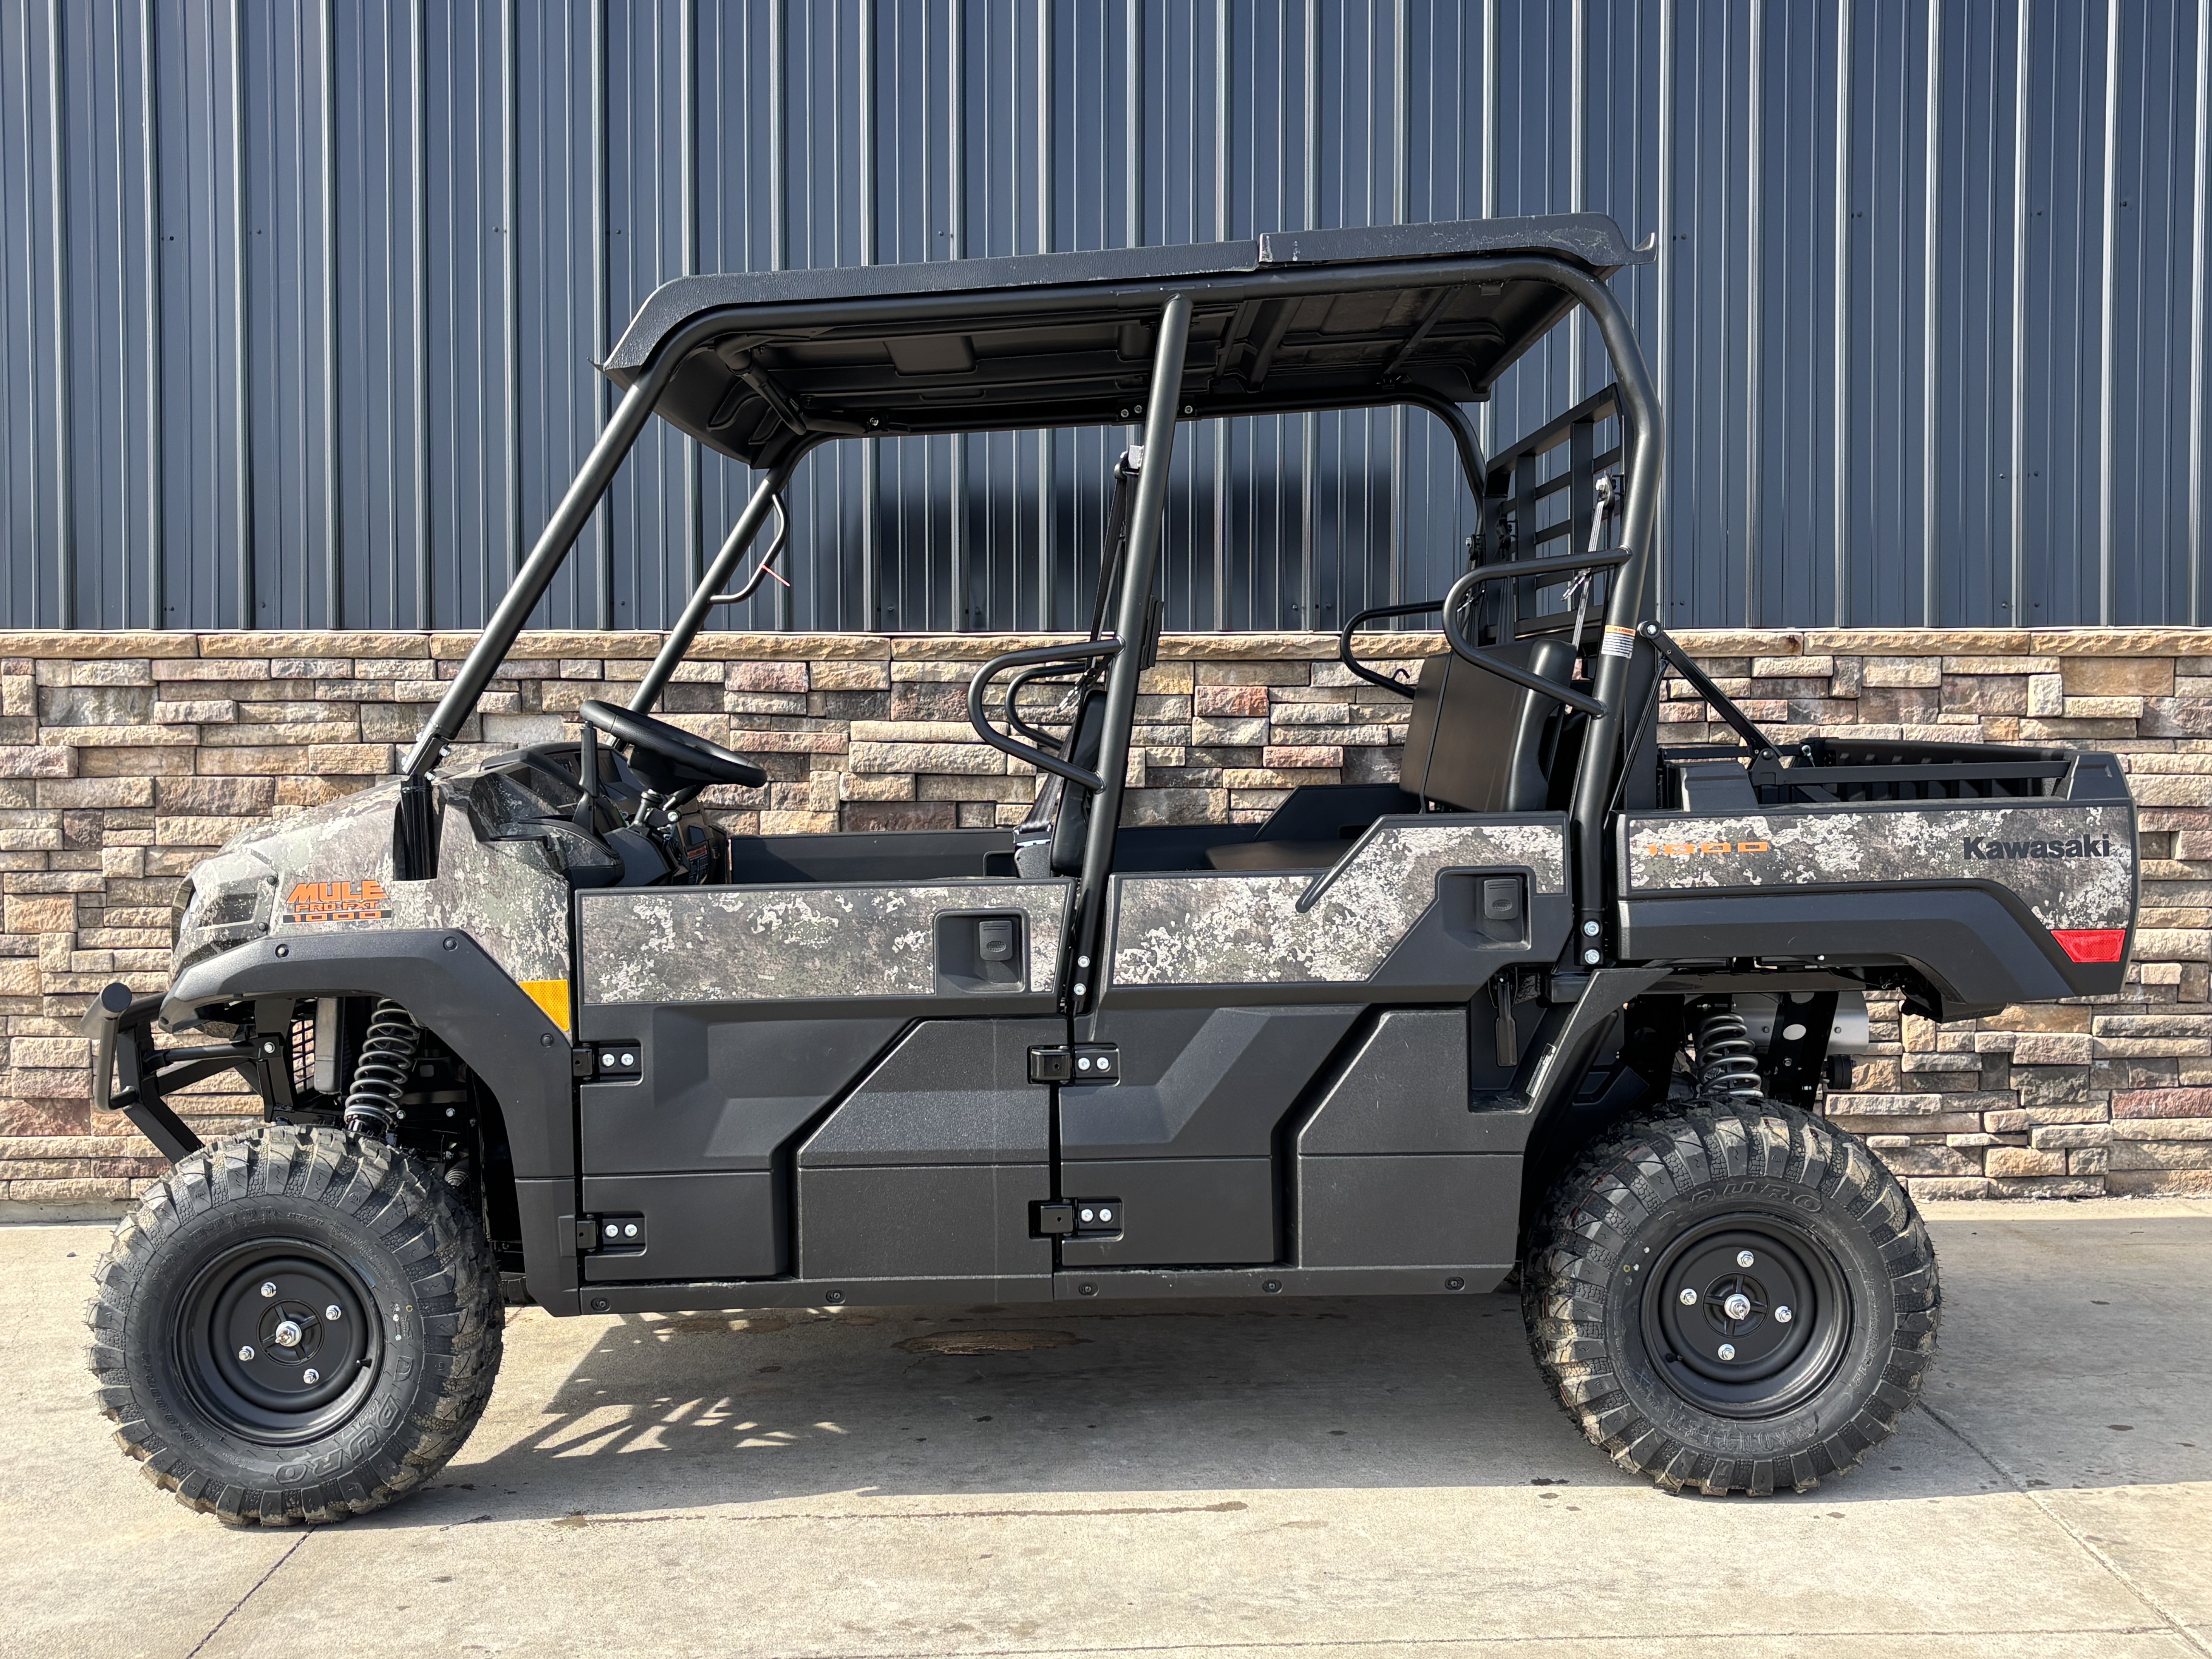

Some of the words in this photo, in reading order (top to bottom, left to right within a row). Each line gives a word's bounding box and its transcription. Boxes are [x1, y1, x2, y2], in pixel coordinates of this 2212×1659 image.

[1648, 841, 1768, 856] 1000
[1963, 834, 2109, 860] Kawasaki
[286, 880, 388, 903] MULE
[293, 911, 381, 922] 1000
[295, 901, 378, 912] PRO-FXT
[1690, 1181, 1822, 1212] DURO
[275, 1393, 400, 1485] DURO
